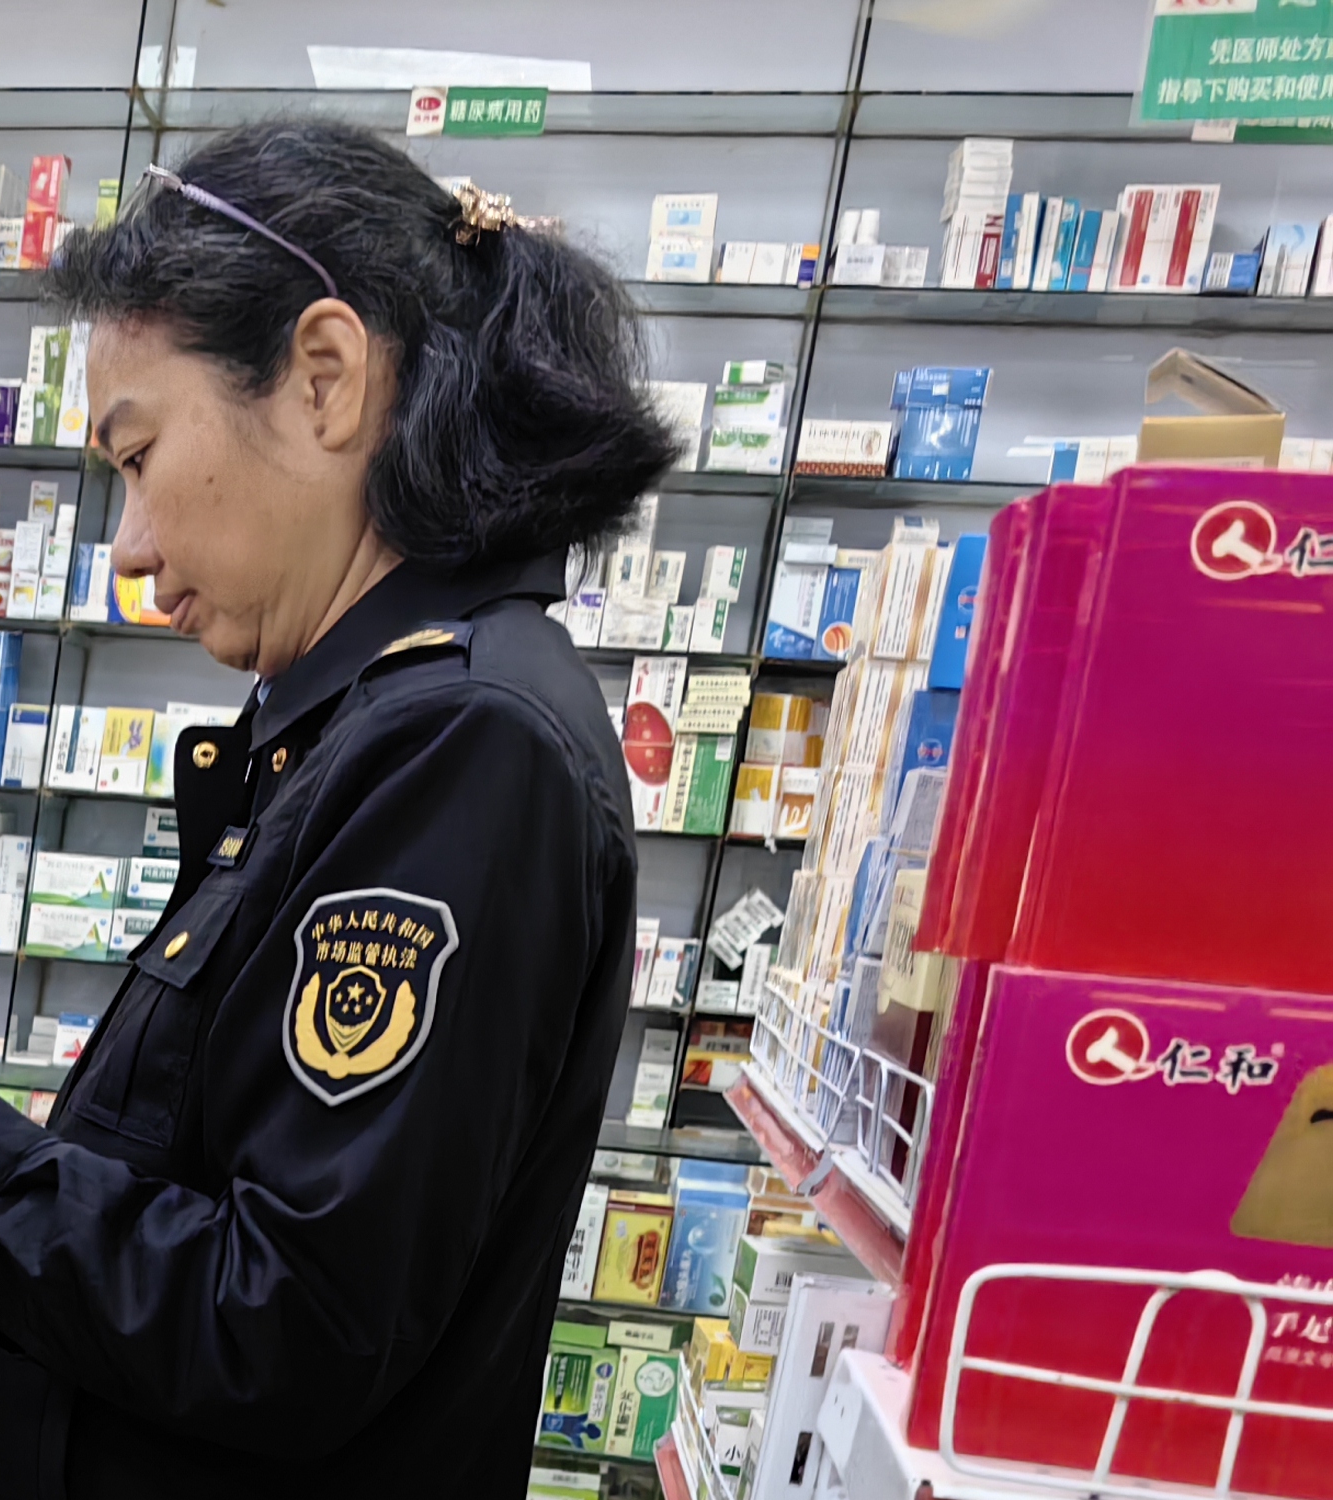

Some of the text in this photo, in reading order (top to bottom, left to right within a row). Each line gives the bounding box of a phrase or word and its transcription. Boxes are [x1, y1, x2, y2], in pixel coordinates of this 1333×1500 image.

[311, 909, 435, 951] 中华人民共和国
[315, 940, 418, 970] 市场监管执法
[1156, 1036, 1278, 1095] 仁和
